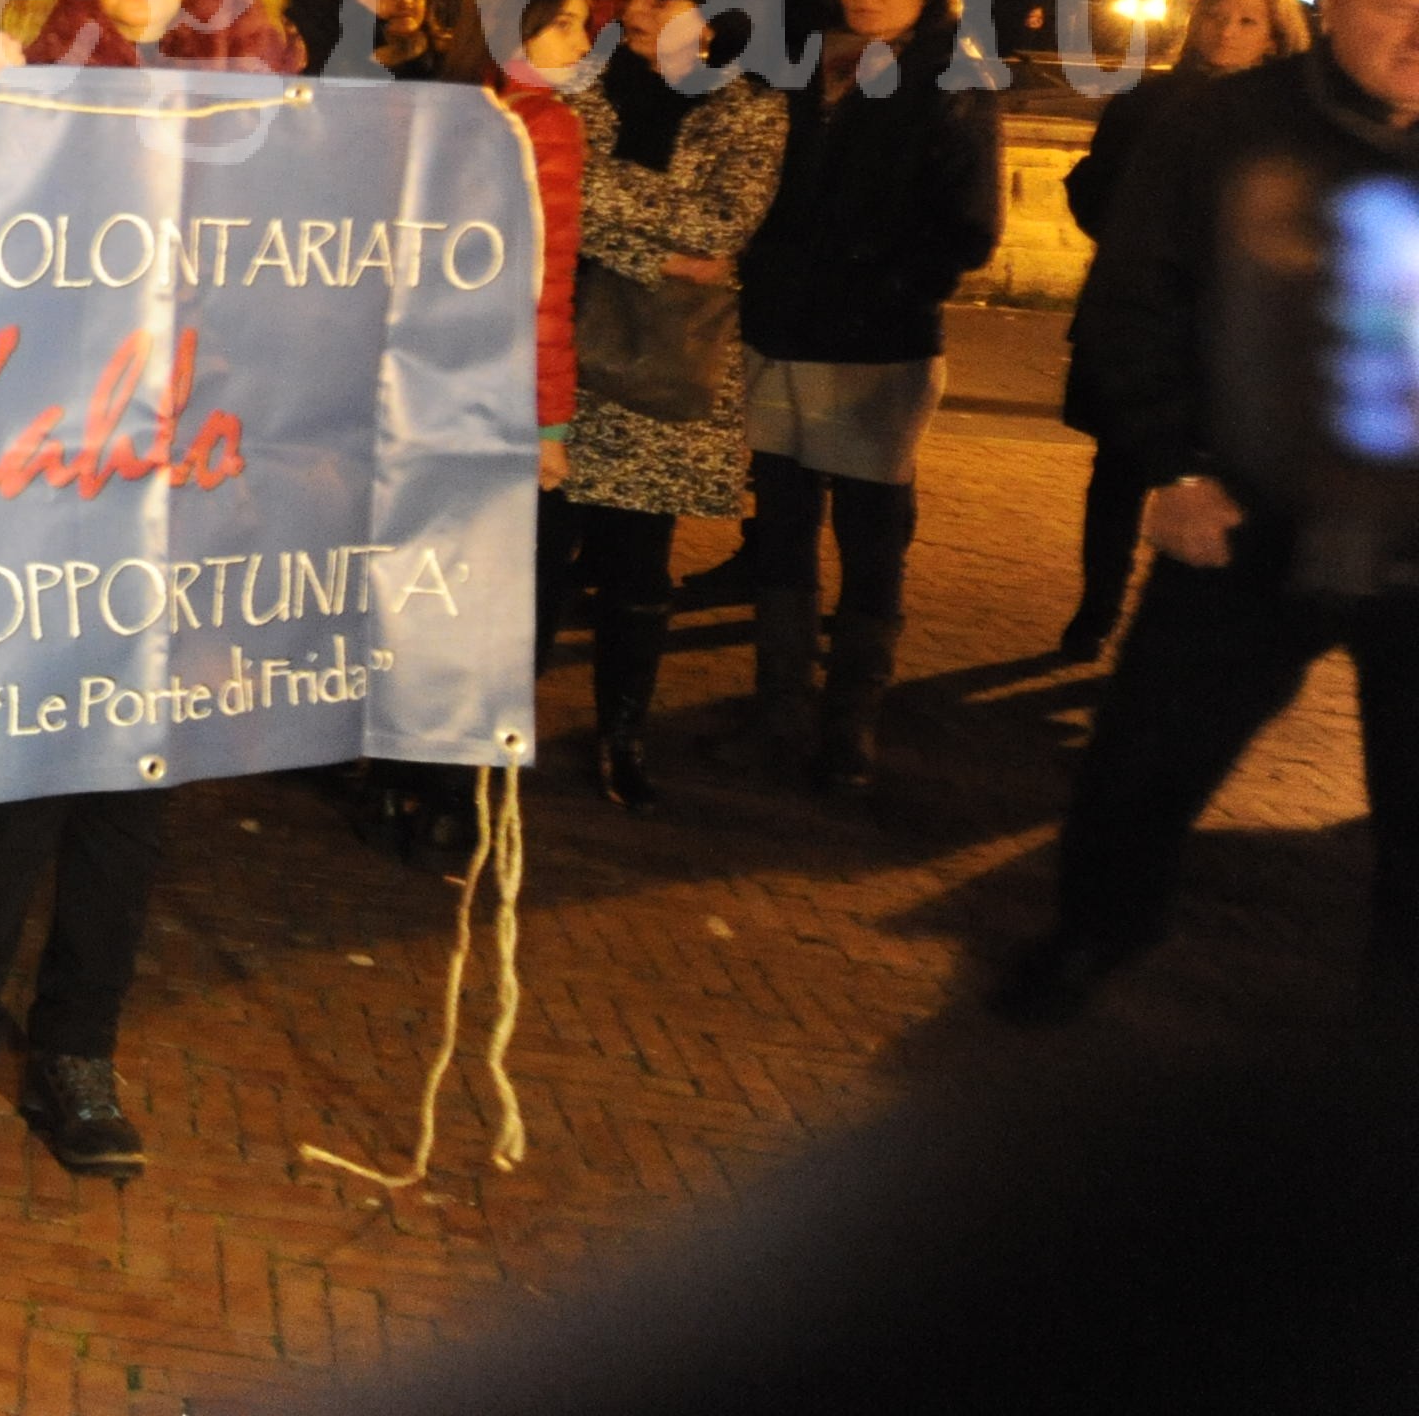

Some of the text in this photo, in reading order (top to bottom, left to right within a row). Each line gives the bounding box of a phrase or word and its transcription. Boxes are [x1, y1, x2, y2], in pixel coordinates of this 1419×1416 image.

[77, 674, 213, 730] Porte
[216, 644, 255, 717] di
[262, 634, 395, 709] Frida”
